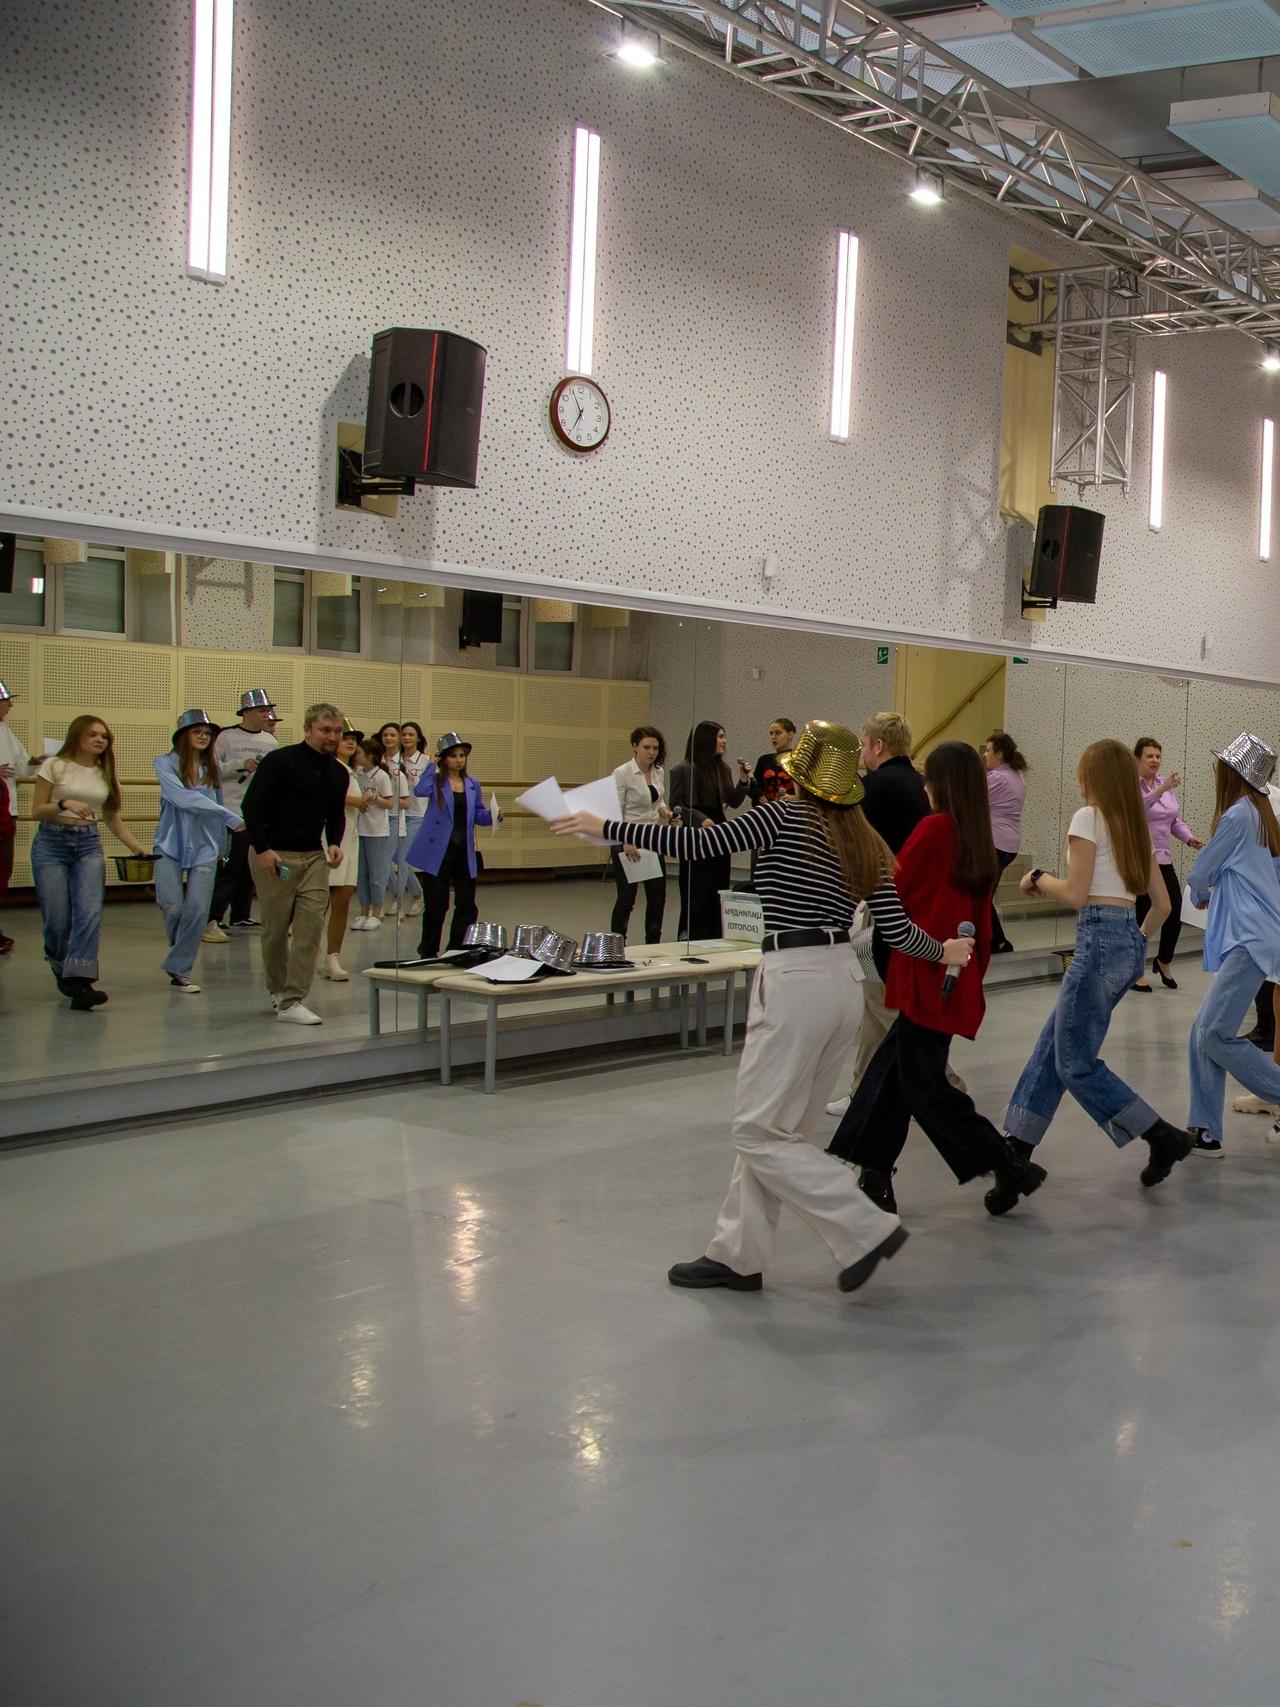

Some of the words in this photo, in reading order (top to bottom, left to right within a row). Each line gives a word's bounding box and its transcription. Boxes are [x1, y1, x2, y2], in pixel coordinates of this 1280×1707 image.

[578, 386, 585, 394] 12
[562, 394, 569, 402] 10
[594, 402, 600, 410] 2
[567, 428, 572, 436] 7
[576, 434, 582, 442] 6
